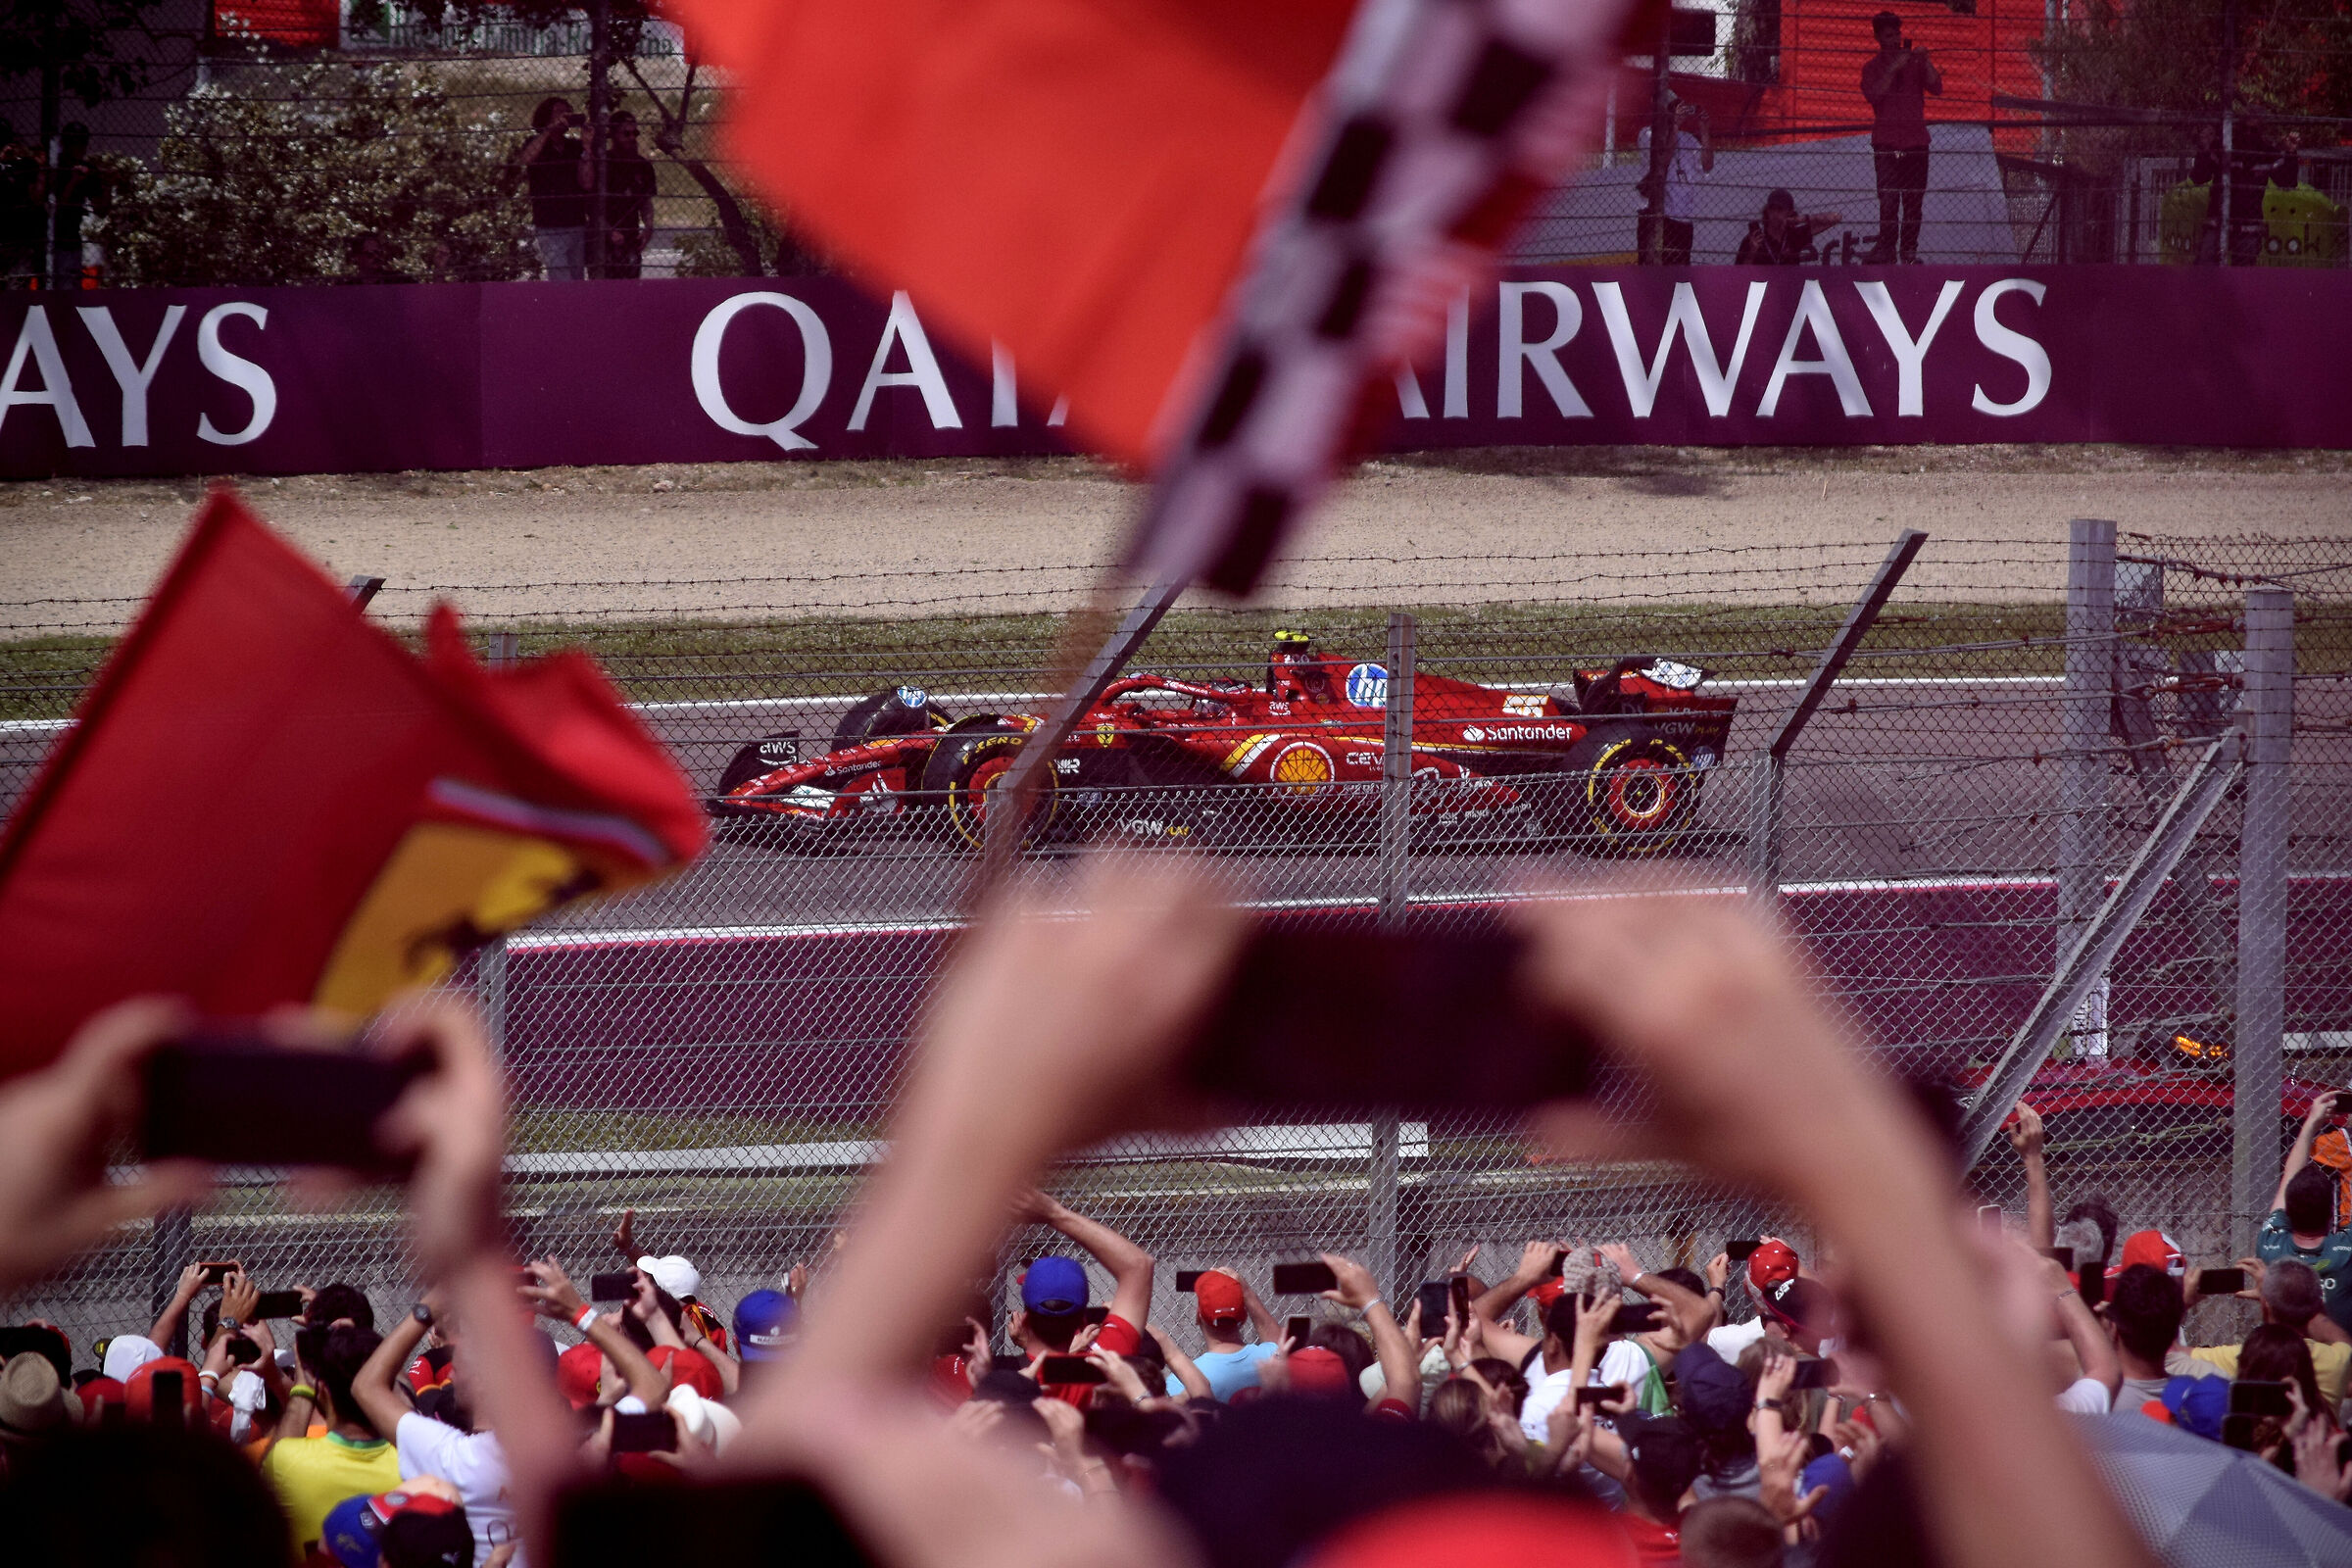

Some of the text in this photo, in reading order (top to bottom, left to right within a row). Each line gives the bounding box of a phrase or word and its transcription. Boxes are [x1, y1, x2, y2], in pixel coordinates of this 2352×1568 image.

[0, 301, 278, 449] AYS
[1486, 724, 1572, 741] Santander
[1346, 752, 1385, 765] CEV
[836, 760, 883, 775] Santander
